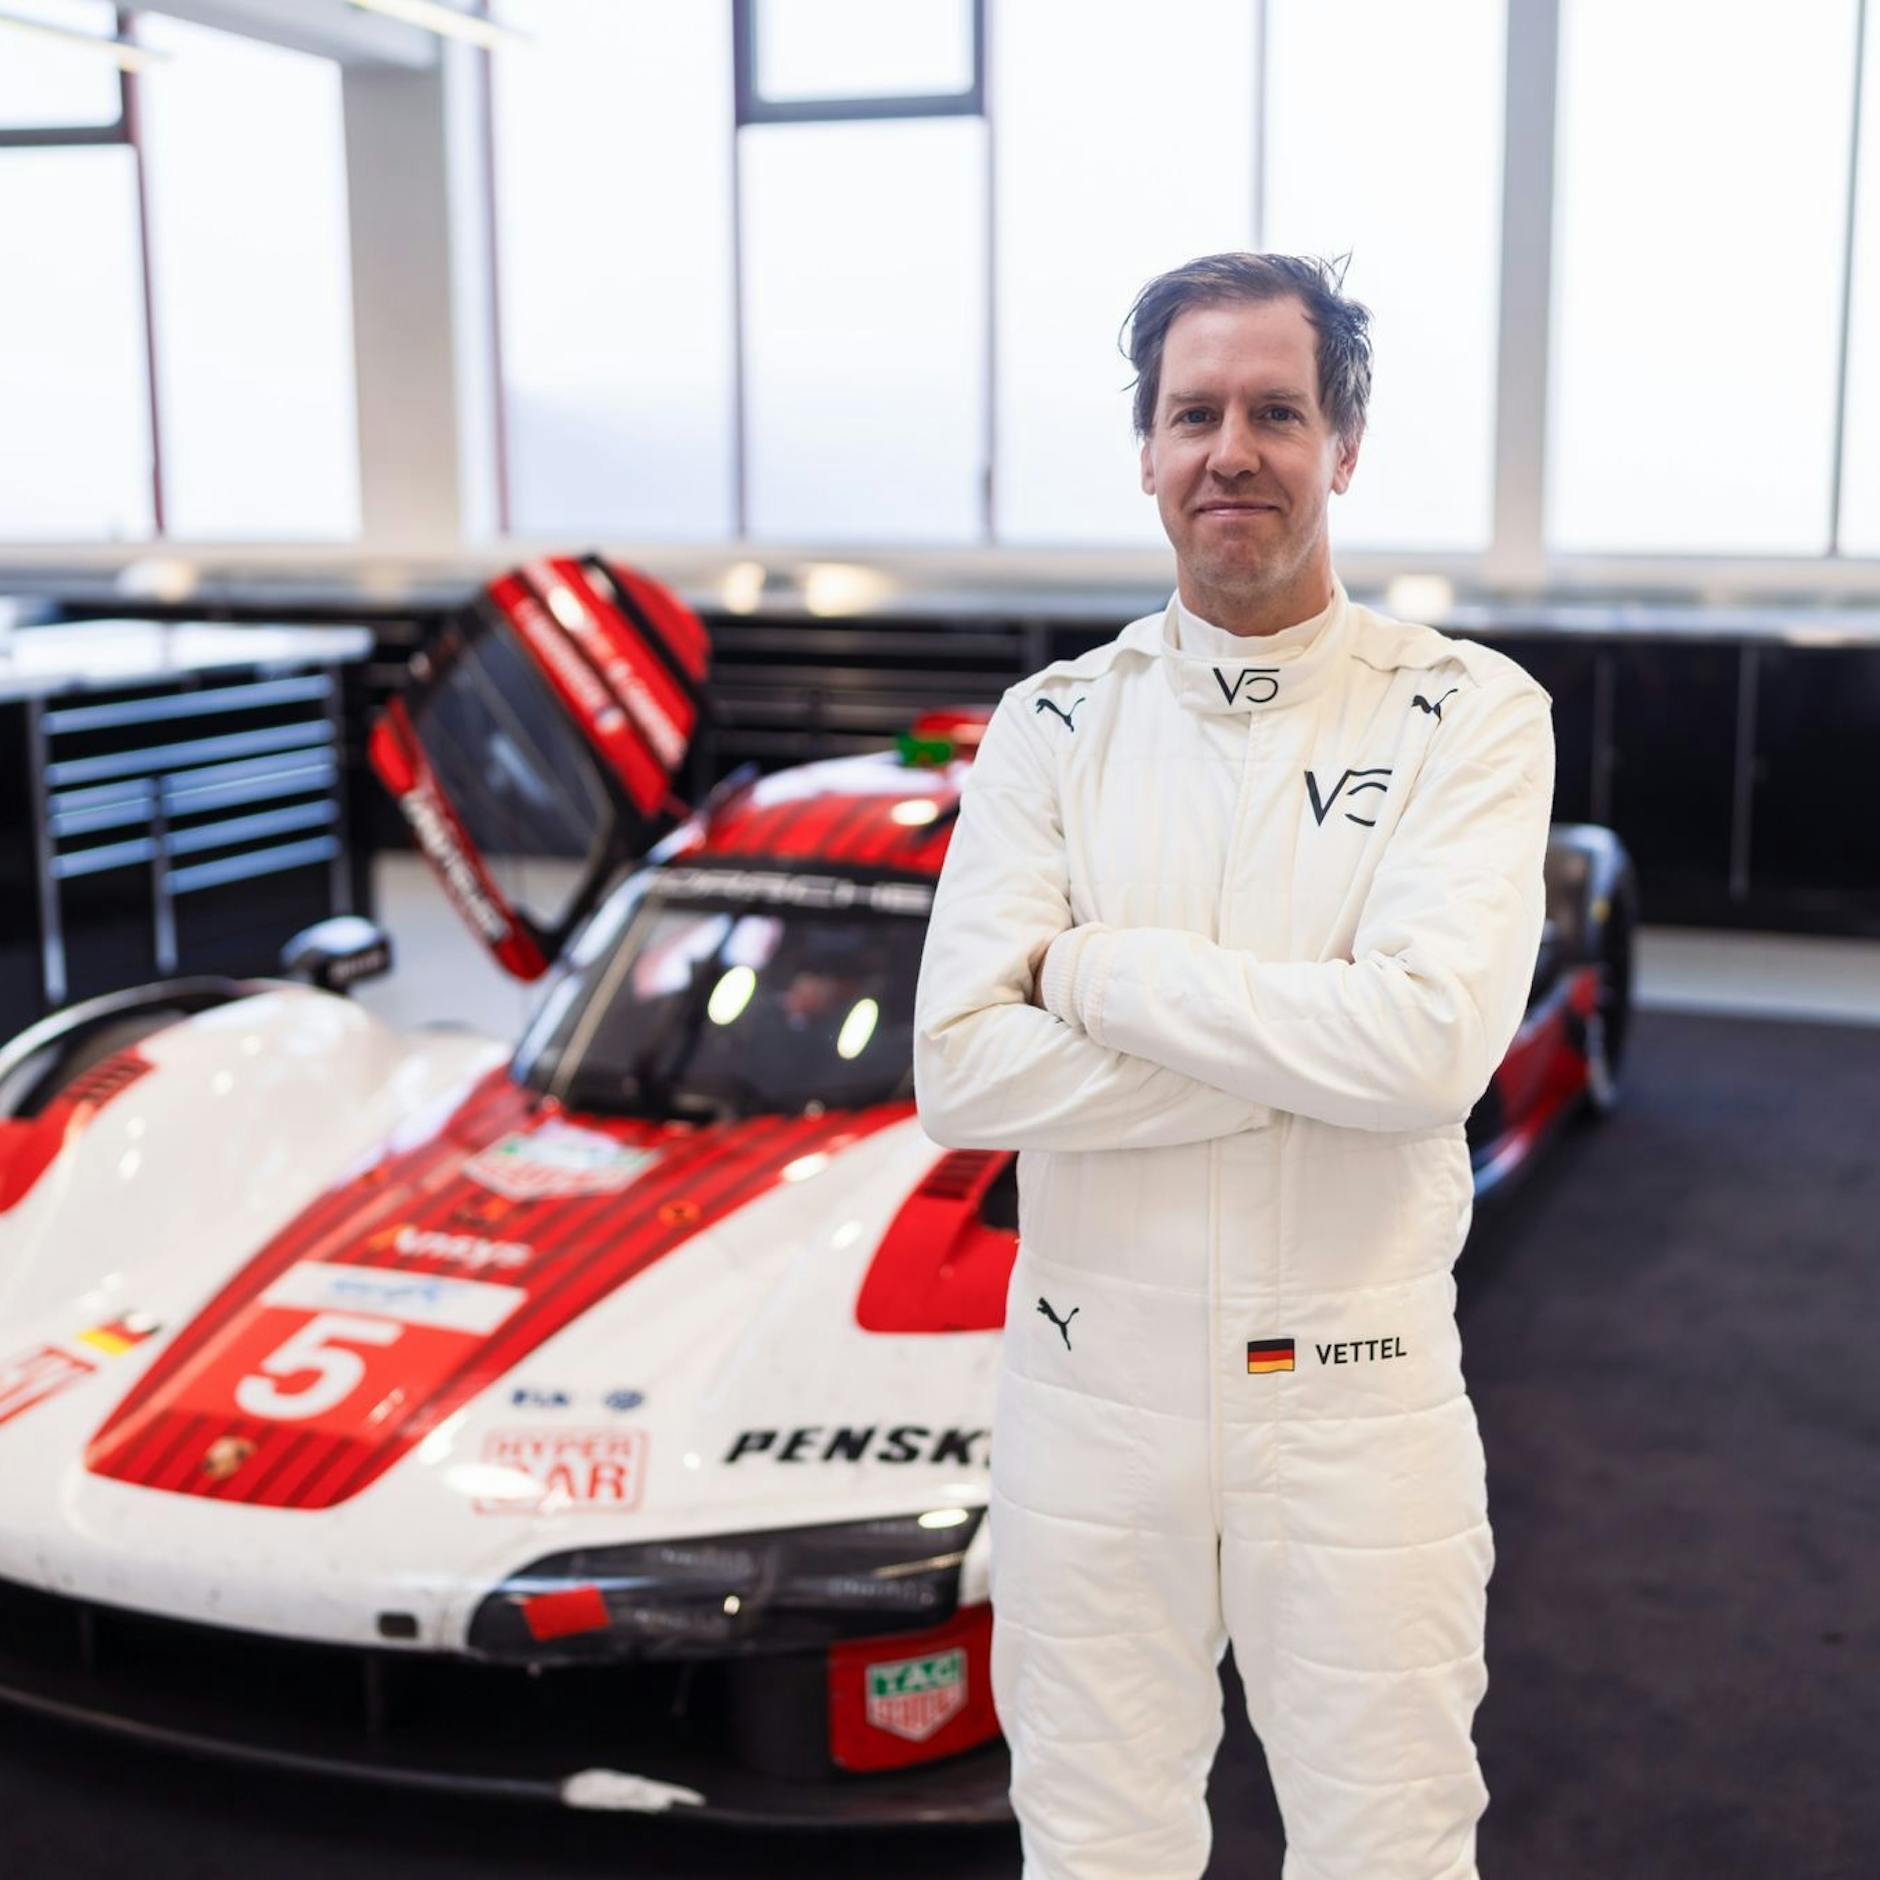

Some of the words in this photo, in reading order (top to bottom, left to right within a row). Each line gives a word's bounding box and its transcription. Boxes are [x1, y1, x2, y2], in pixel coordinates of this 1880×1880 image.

[234, 1312, 405, 1421] 5
[1315, 1336, 1407, 1365] VETTEL
[722, 1425, 991, 1468] PENSK
[490, 1460, 629, 1502] AR
